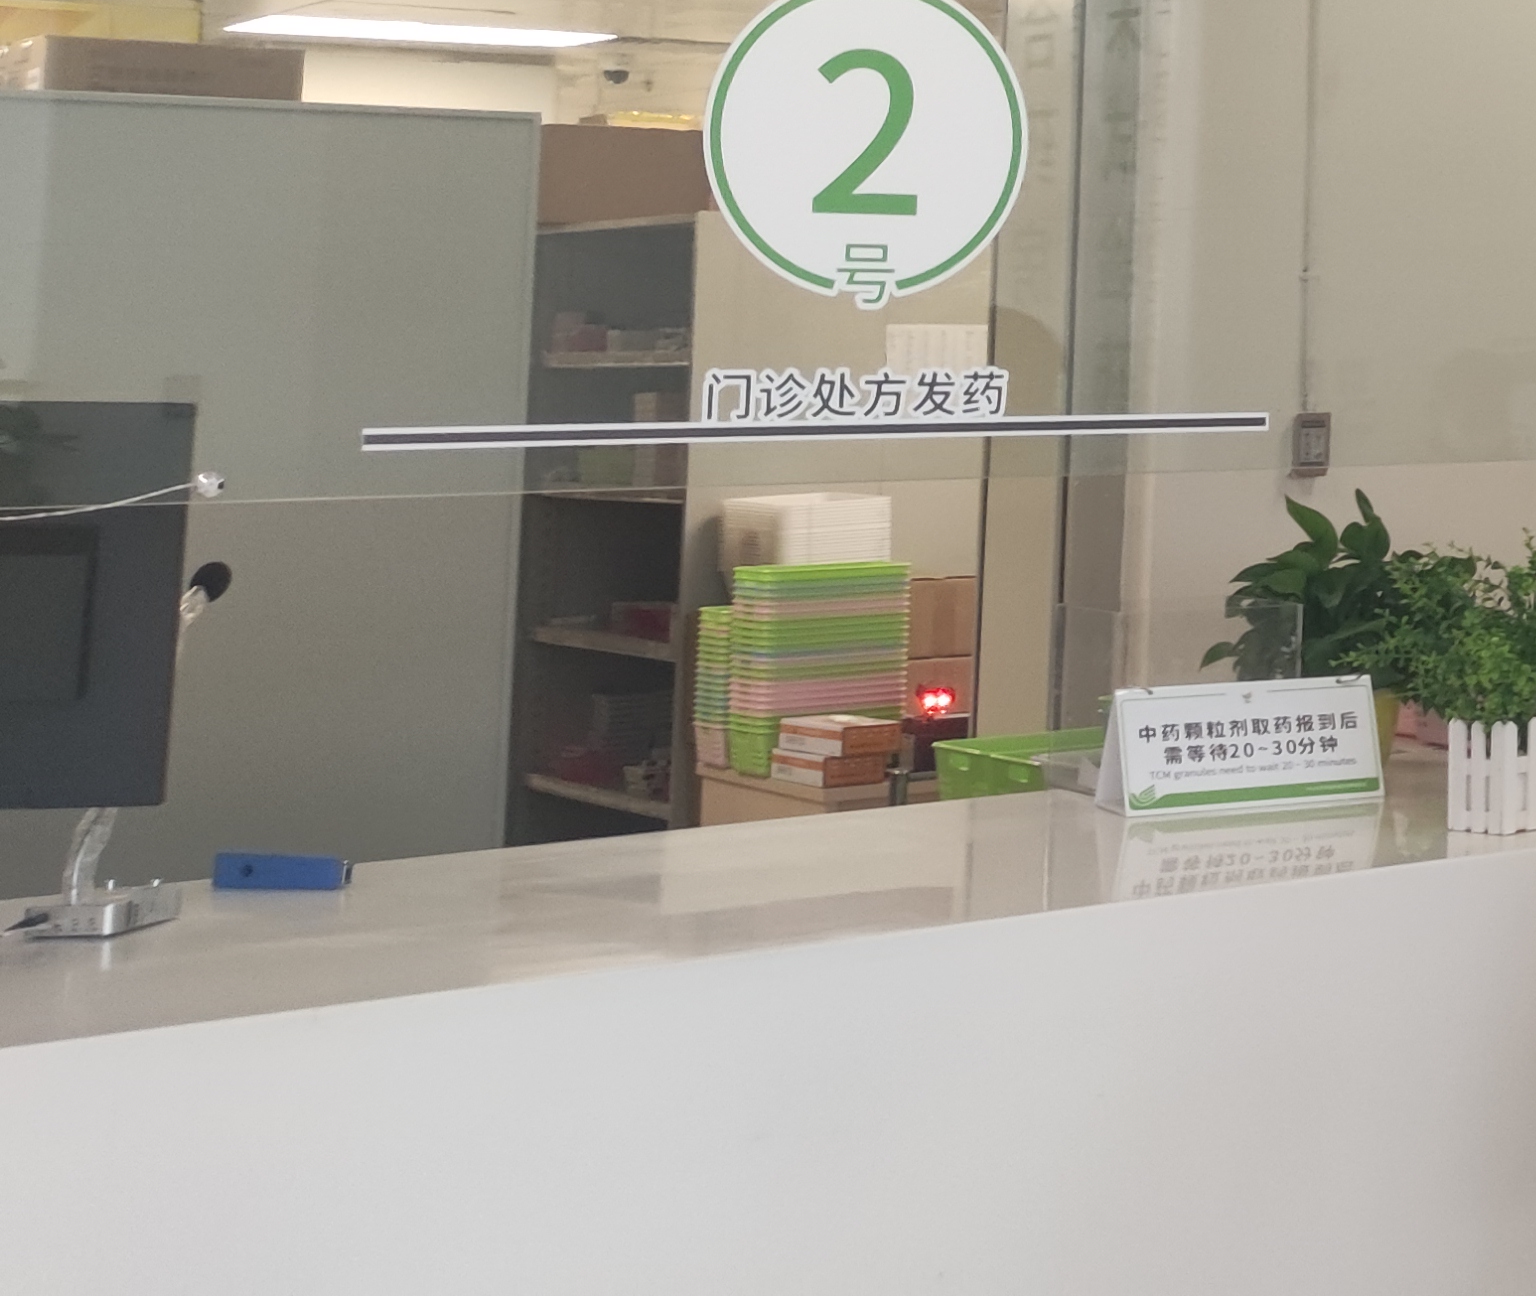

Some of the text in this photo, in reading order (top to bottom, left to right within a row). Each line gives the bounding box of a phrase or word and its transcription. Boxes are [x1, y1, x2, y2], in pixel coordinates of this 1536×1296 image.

[812, 48, 918, 217] 2
[836, 243, 896, 306] 号
[705, 370, 1008, 421] 门诊处方发药
[1138, 711, 1360, 744] 中药颗粒剂取药报到后
[1219, 764, 1244, 775] need
[1246, 765, 1255, 773] to
[1258, 762, 1279, 772] wait
[1317, 757, 1357, 768] minutes
